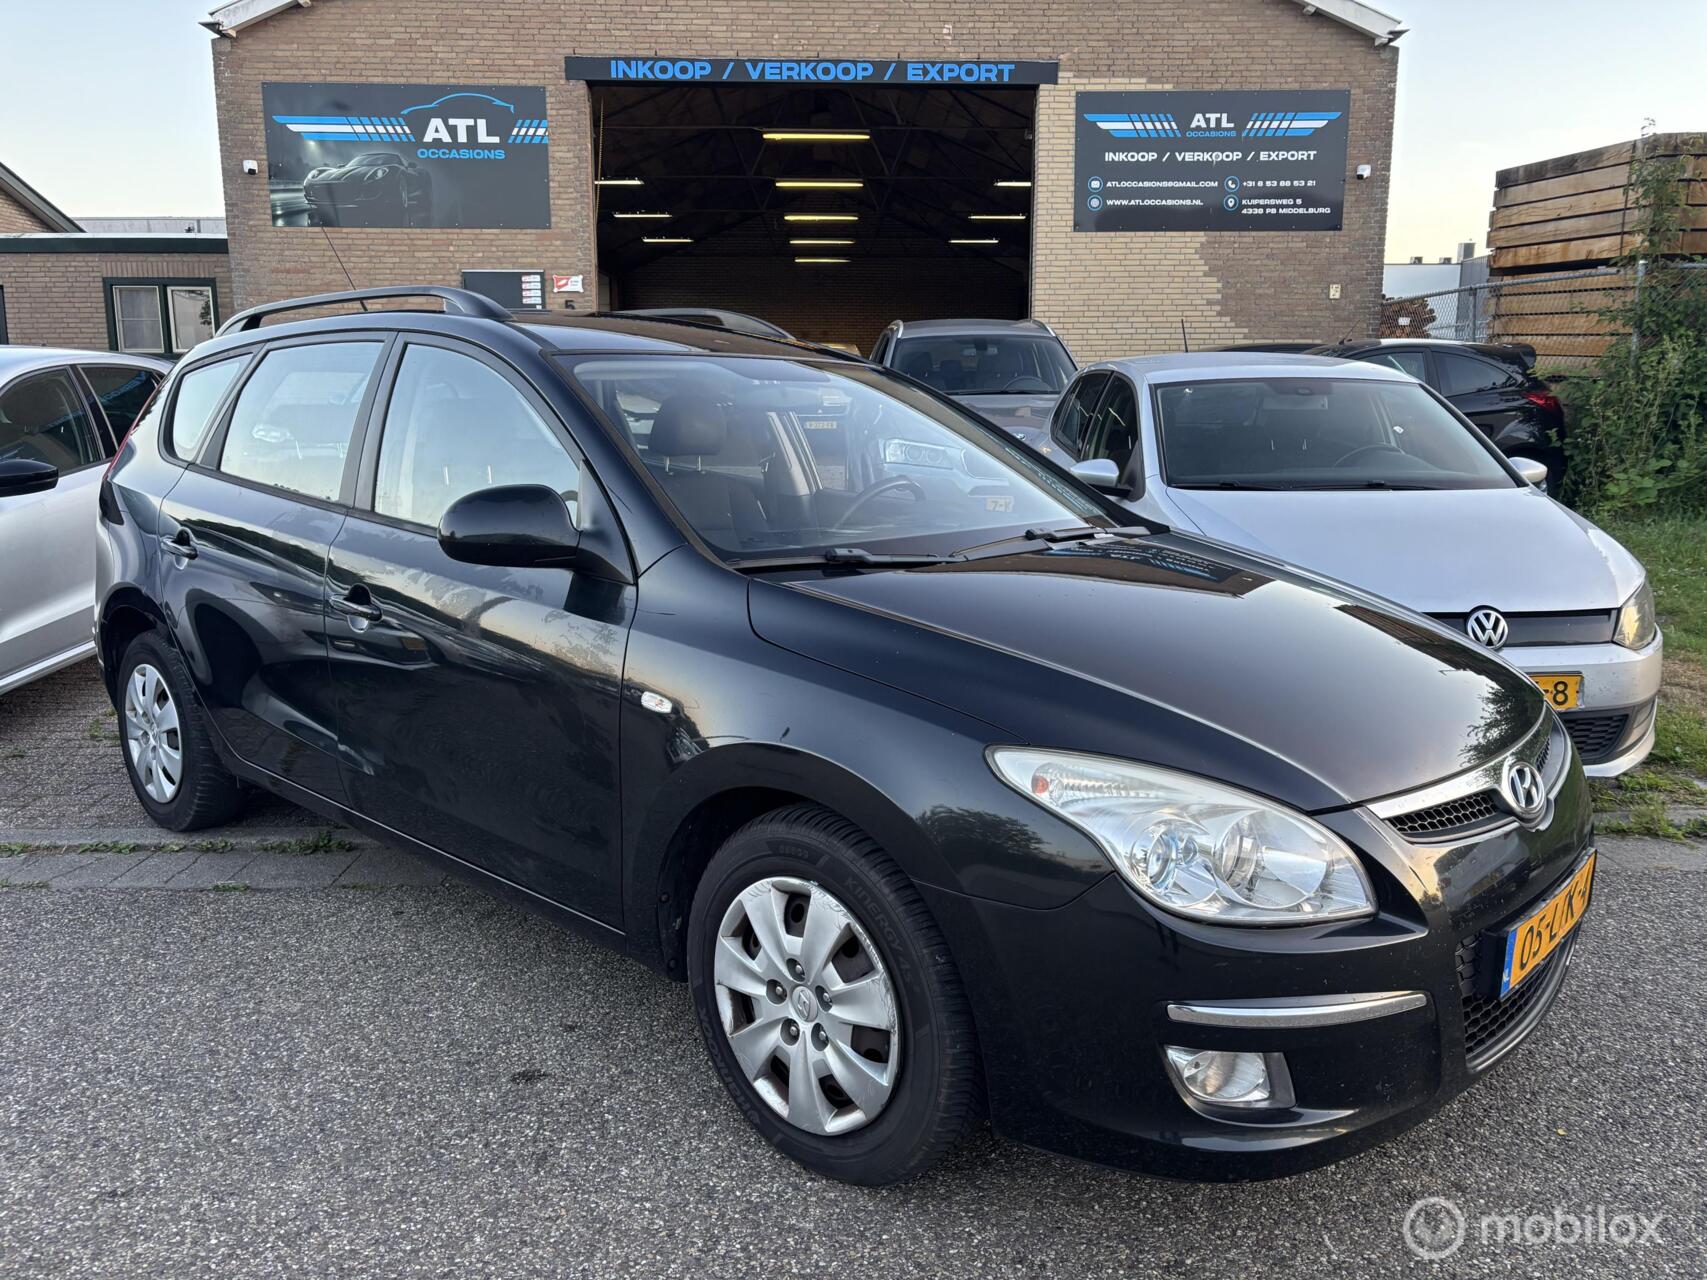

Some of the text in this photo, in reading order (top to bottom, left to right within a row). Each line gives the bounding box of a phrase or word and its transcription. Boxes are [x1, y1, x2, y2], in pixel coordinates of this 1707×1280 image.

[609, 60, 1016, 82] INKOOP / VERKOOP / EXPORT
[1189, 112, 1235, 128] ATL
[422, 117, 500, 143] ATL
[1185, 130, 1237, 138] OCCASIONS
[416, 148, 506, 160] OCCASIONS
[1104, 151, 1158, 162] INKOOP
[1174, 151, 1243, 162] VERKOOP
[1259, 150, 1318, 161] EXPORT
[1241, 198, 1294, 206] KUIPERSWEG
[1278, 206, 1331, 214] MIDDELBURG
